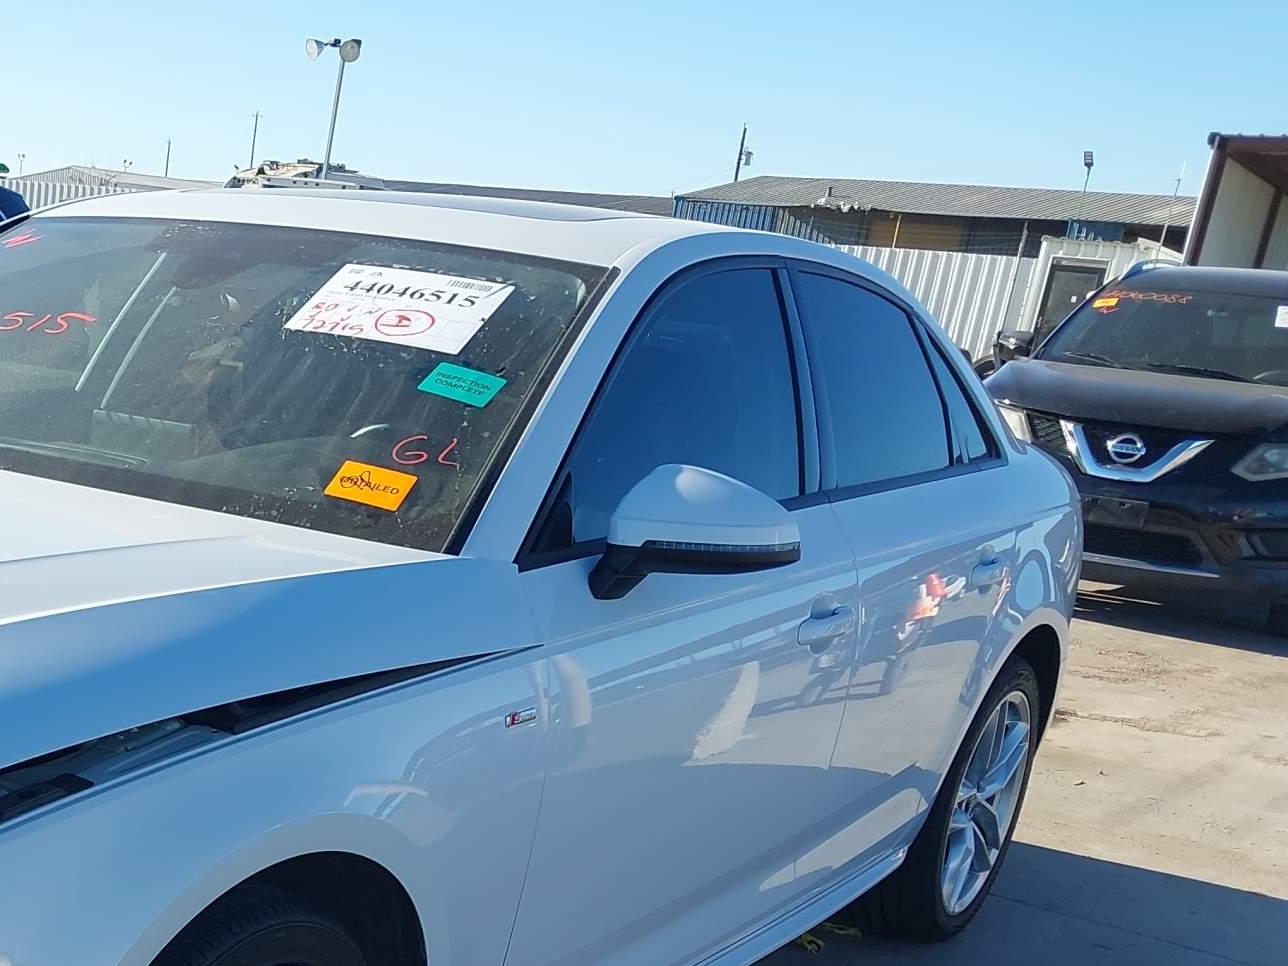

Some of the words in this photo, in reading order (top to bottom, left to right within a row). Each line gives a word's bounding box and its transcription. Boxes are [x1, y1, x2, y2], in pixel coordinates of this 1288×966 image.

[343, 279, 480, 308] 44046515
[434, 378, 485, 396] COMPLETE
[435, 371, 493, 392] INSPECTION
